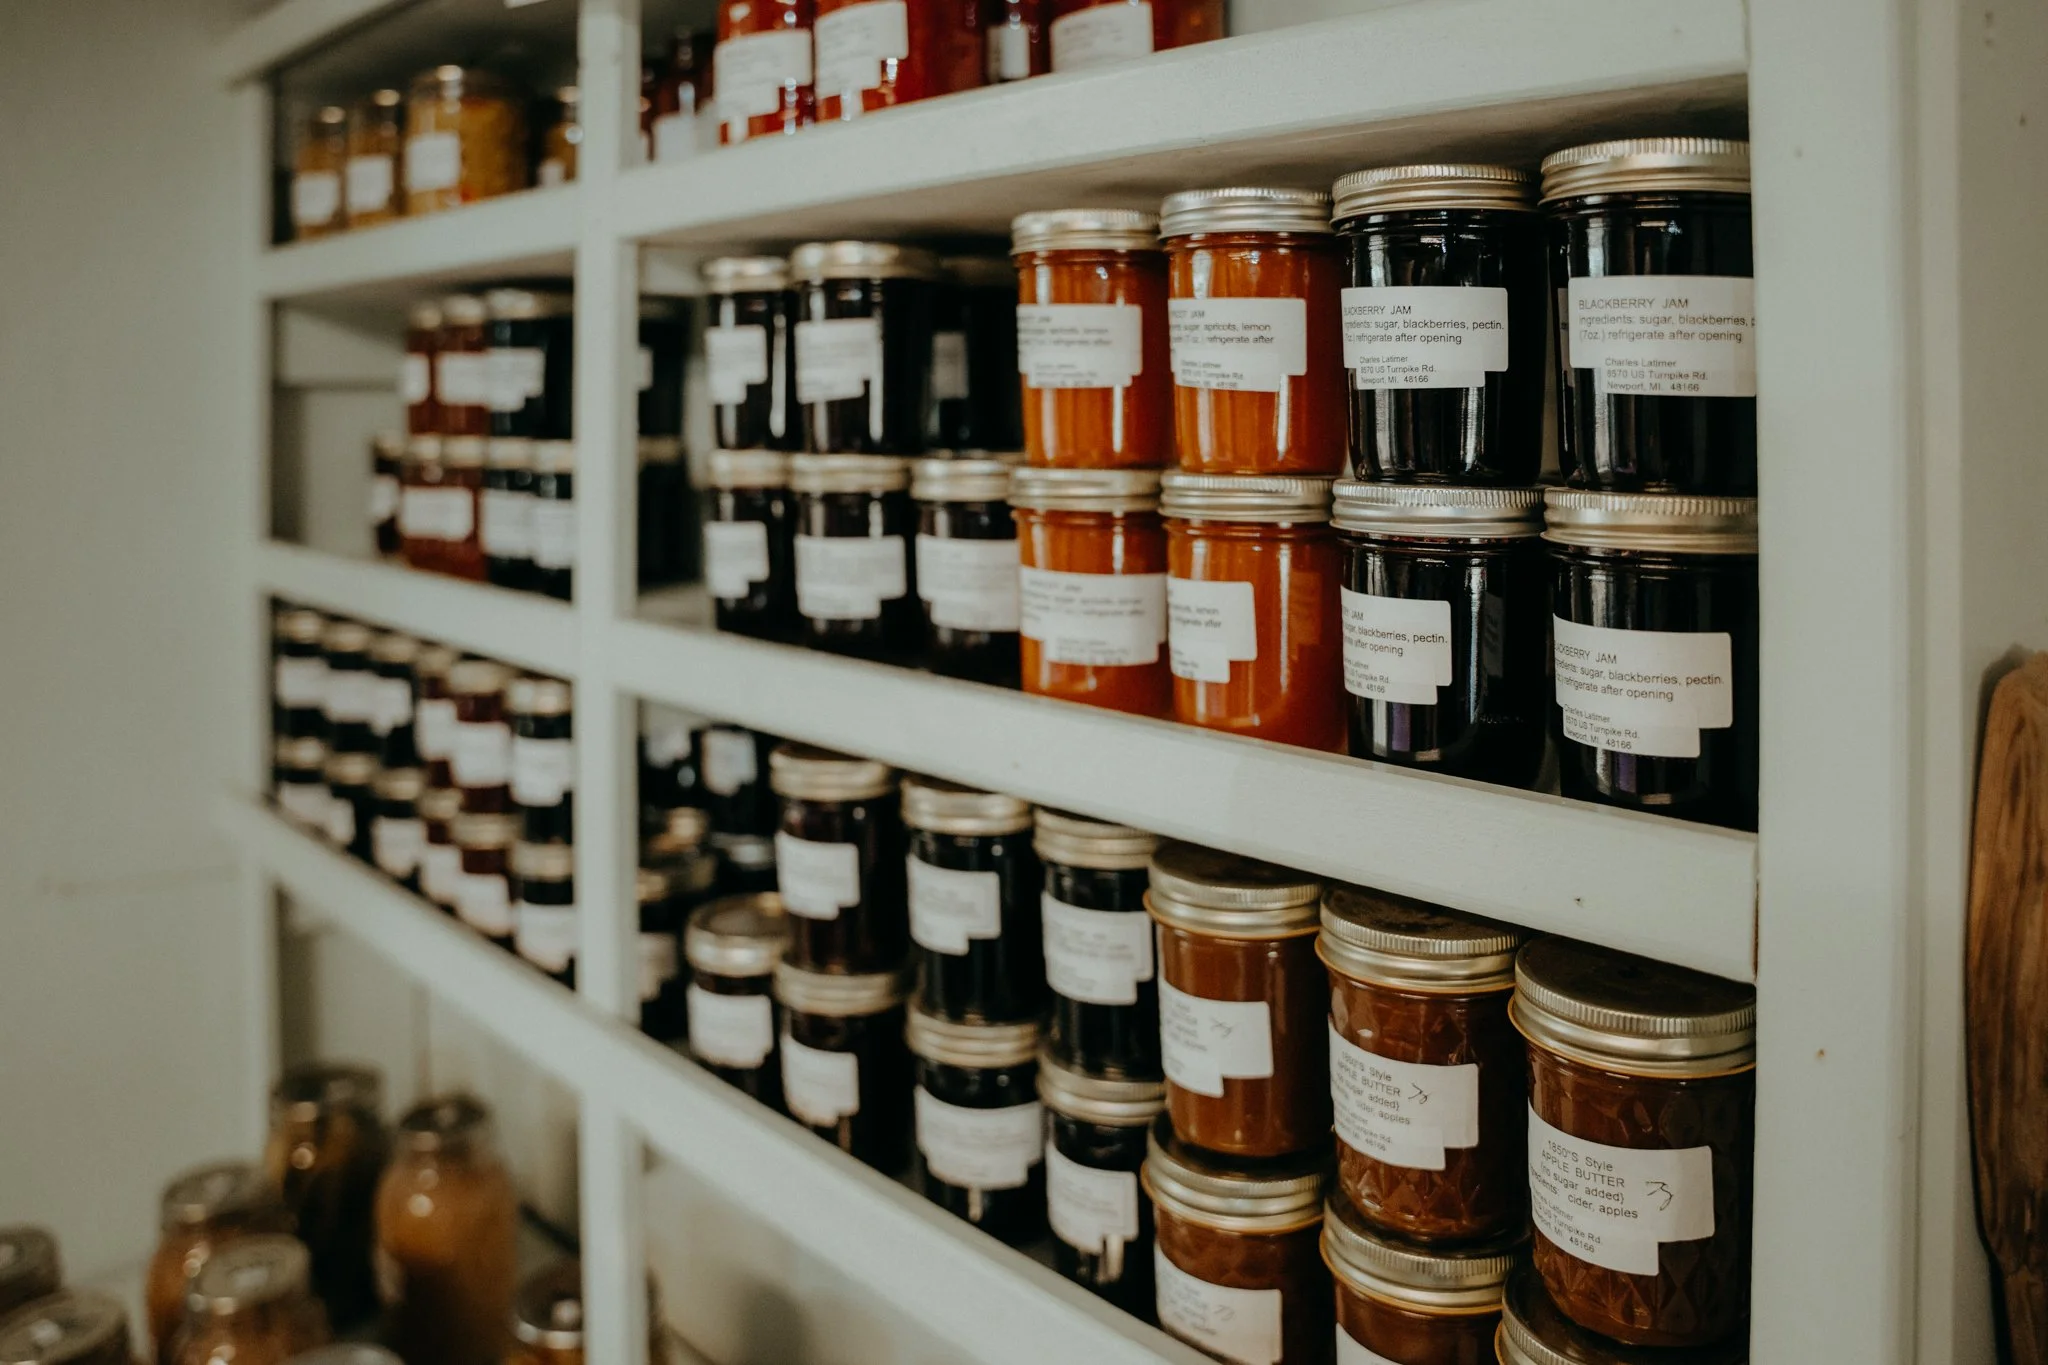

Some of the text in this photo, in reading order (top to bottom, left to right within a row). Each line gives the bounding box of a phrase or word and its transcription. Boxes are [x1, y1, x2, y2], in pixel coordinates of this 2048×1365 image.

[1391, 305, 1411, 315] JAM
[1578, 298, 1689, 310] BLACKBERRY JAM
[1242, 322, 1271, 331] lemon
[1375, 321, 1400, 331] sugar,
[1403, 319, 1468, 330] blackberries,
[1472, 319, 1504, 331] pectin.
[1678, 314, 1748, 327] blackberries,
[1252, 335, 1274, 344] after
[1395, 332, 1417, 342] after
[1420, 333, 1462, 345] opening
[1608, 329, 1665, 342] refrigerate
[1668, 329, 1695, 341] after
[1698, 331, 1742, 344] opening
[1382, 355, 1408, 363] Latimer
[1605, 358, 1677, 367] Charles Latimer
[1375, 366, 1385, 374] US
[1387, 365, 1419, 374] Turnpike
[1422, 364, 1436, 372] Rd.
[1631, 370, 1645, 379] US
[1649, 370, 1689, 380] Turnpike
[1692, 371, 1708, 380] Rd.
[1404, 375, 1429, 383] 48166
[1670, 383, 1700, 392] 48166
[1358, 626, 1410, 643] blackberries,
[1413, 633, 1448, 644] pectin.
[1369, 642, 1403, 657] opening
[1595, 653, 1617, 664] JAM
[1580, 666, 1606, 679] sugar,
[1609, 669, 1681, 686] blackberries,
[1686, 674, 1724, 687] pectin.
[1366, 683, 1385, 693] 48166
[1601, 684, 1623, 696] after
[1626, 688, 1674, 702] opening
[1579, 718, 1588, 730] US
[1589, 723, 1621, 738] Turnpike
[1624, 729, 1639, 739] Rd.
[1606, 739, 1632, 750] 48166
[1369, 1066, 1392, 1082] Style
[1361, 1076, 1401, 1097] BUTTER
[1378, 1110, 1411, 1126] apples
[1542, 1149, 1625, 1188] APPLE BUTTER
[1585, 1156, 1613, 1172] Style
[1553, 1172, 1579, 1190] sugar
[1568, 1194, 1595, 1211] cider,
[1599, 1204, 1638, 1219] apples
[1554, 1214, 1585, 1238] Turnpike
[1588, 1232, 1602, 1245] Rd.
[1569, 1236, 1595, 1253] 48166
